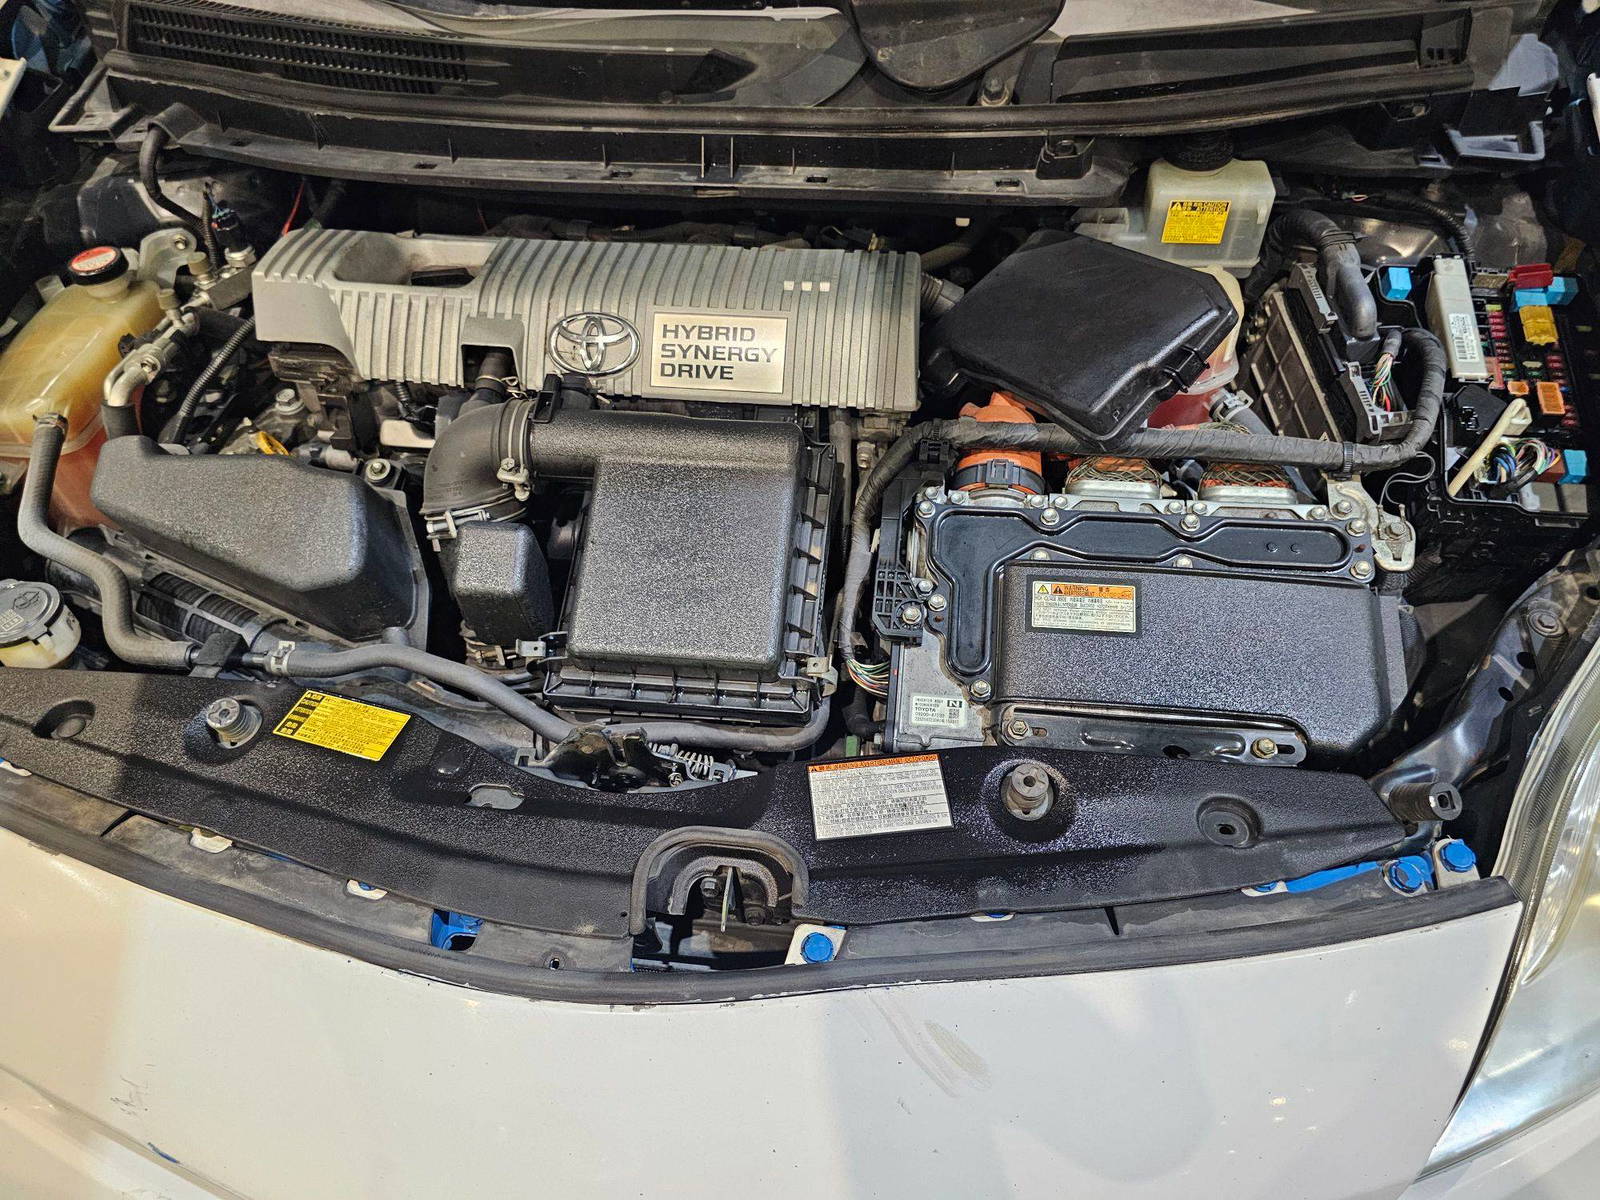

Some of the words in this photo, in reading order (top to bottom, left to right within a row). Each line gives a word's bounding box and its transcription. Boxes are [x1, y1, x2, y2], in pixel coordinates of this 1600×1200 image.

[662, 324, 756, 342] HYBRID
[660, 344, 779, 363] SYNERGY
[660, 363, 734, 380] DRIVE
